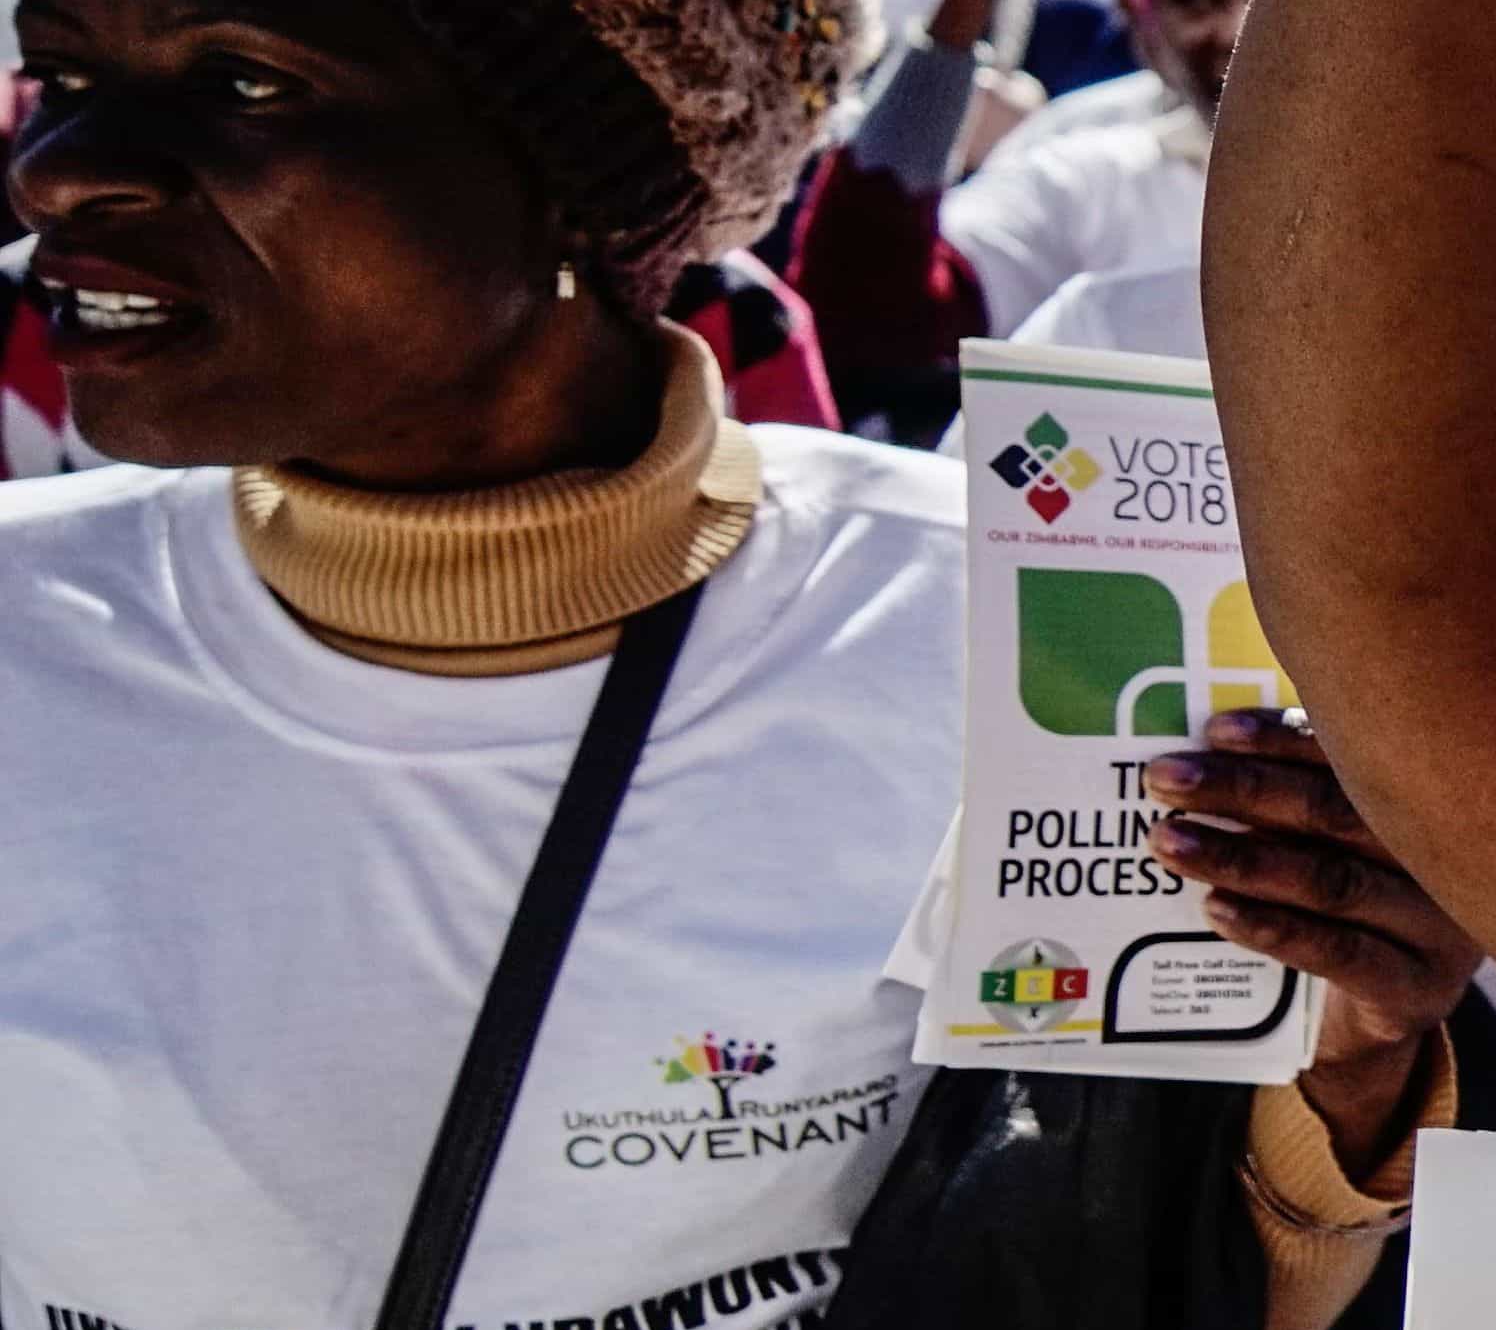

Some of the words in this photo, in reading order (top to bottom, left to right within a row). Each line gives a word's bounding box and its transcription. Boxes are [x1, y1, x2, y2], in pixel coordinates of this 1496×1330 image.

[1109, 434, 1229, 481] VOTE
[1113, 477, 1228, 526] 2018
[1008, 809, 1187, 849] POLLIN
[998, 857, 1185, 899] PROCESS
[562, 1108, 715, 1131] UKUTHULA
[564, 1091, 901, 1170] COVENANT
